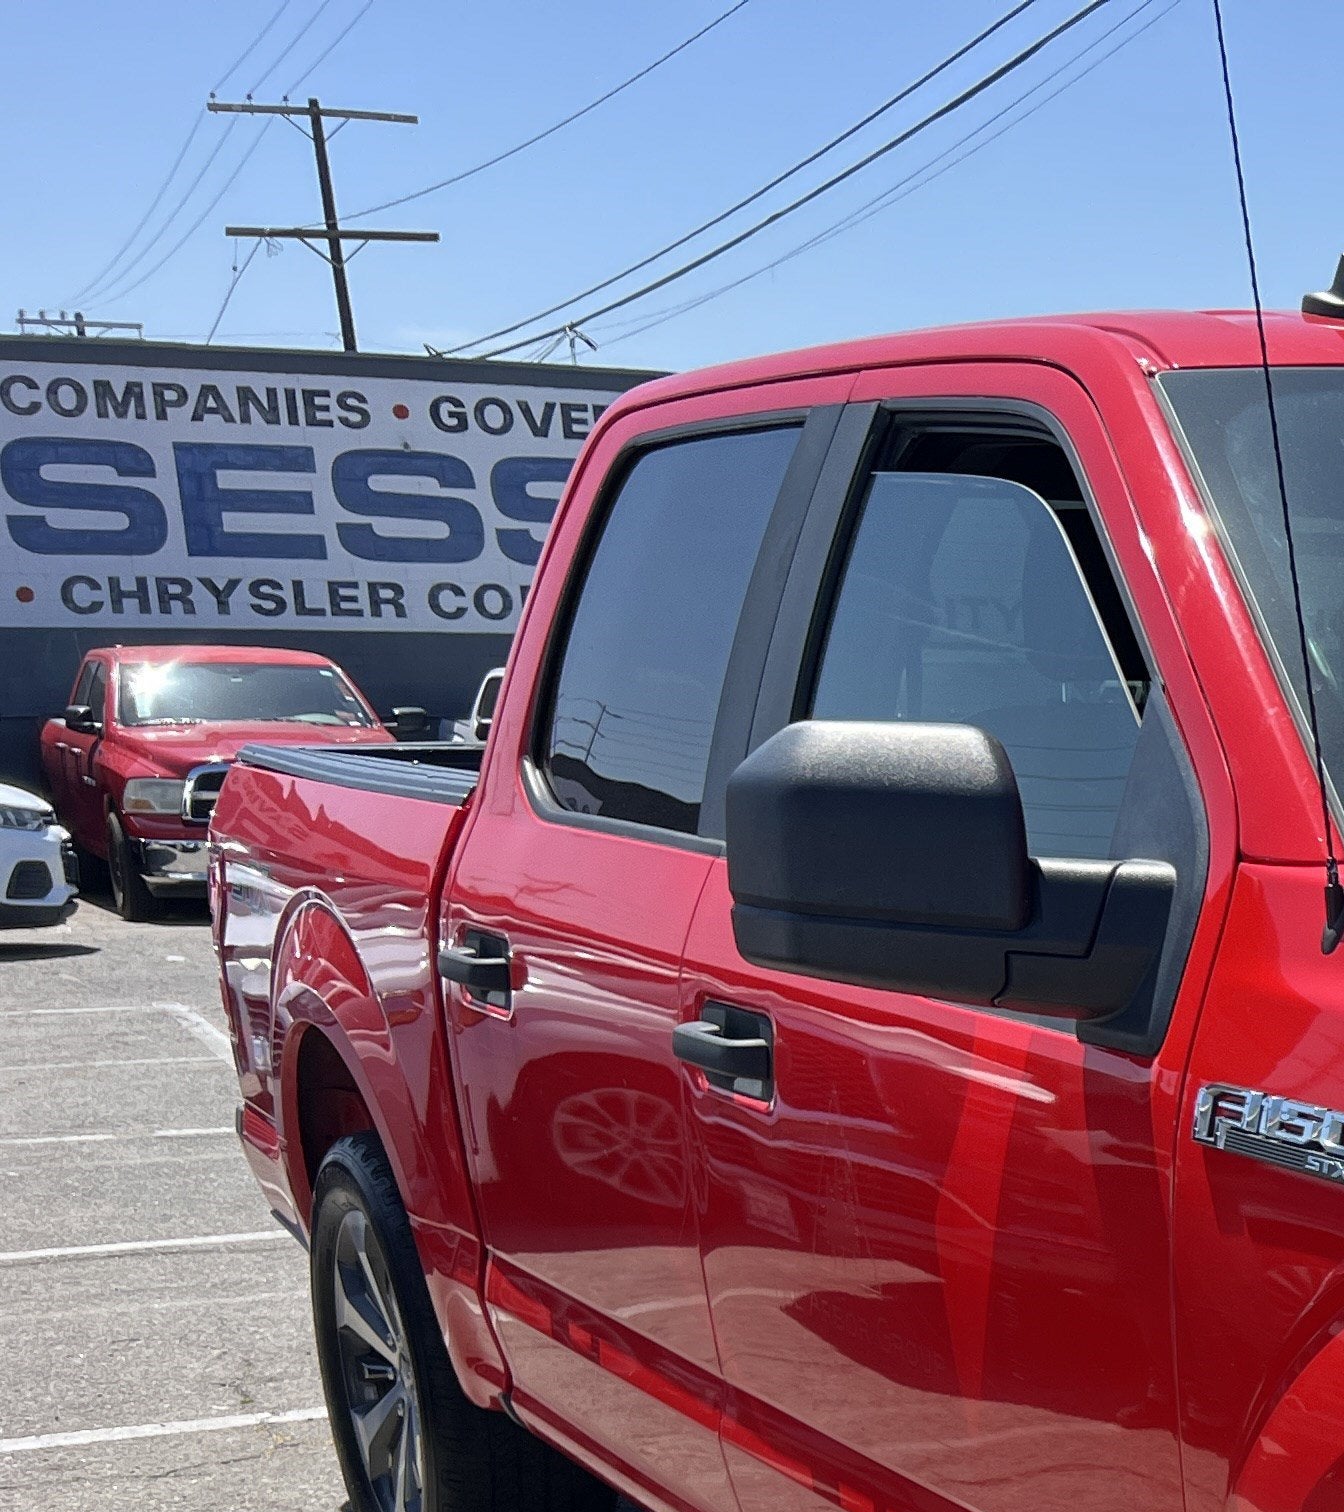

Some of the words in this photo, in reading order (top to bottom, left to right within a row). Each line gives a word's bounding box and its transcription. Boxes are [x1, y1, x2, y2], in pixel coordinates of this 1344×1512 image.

[0, 374, 371, 429] COMPANIES
[429, 396, 609, 440] GOVE
[60, 575, 408, 618] CHRYSLER
[428, 583, 530, 621] CO
